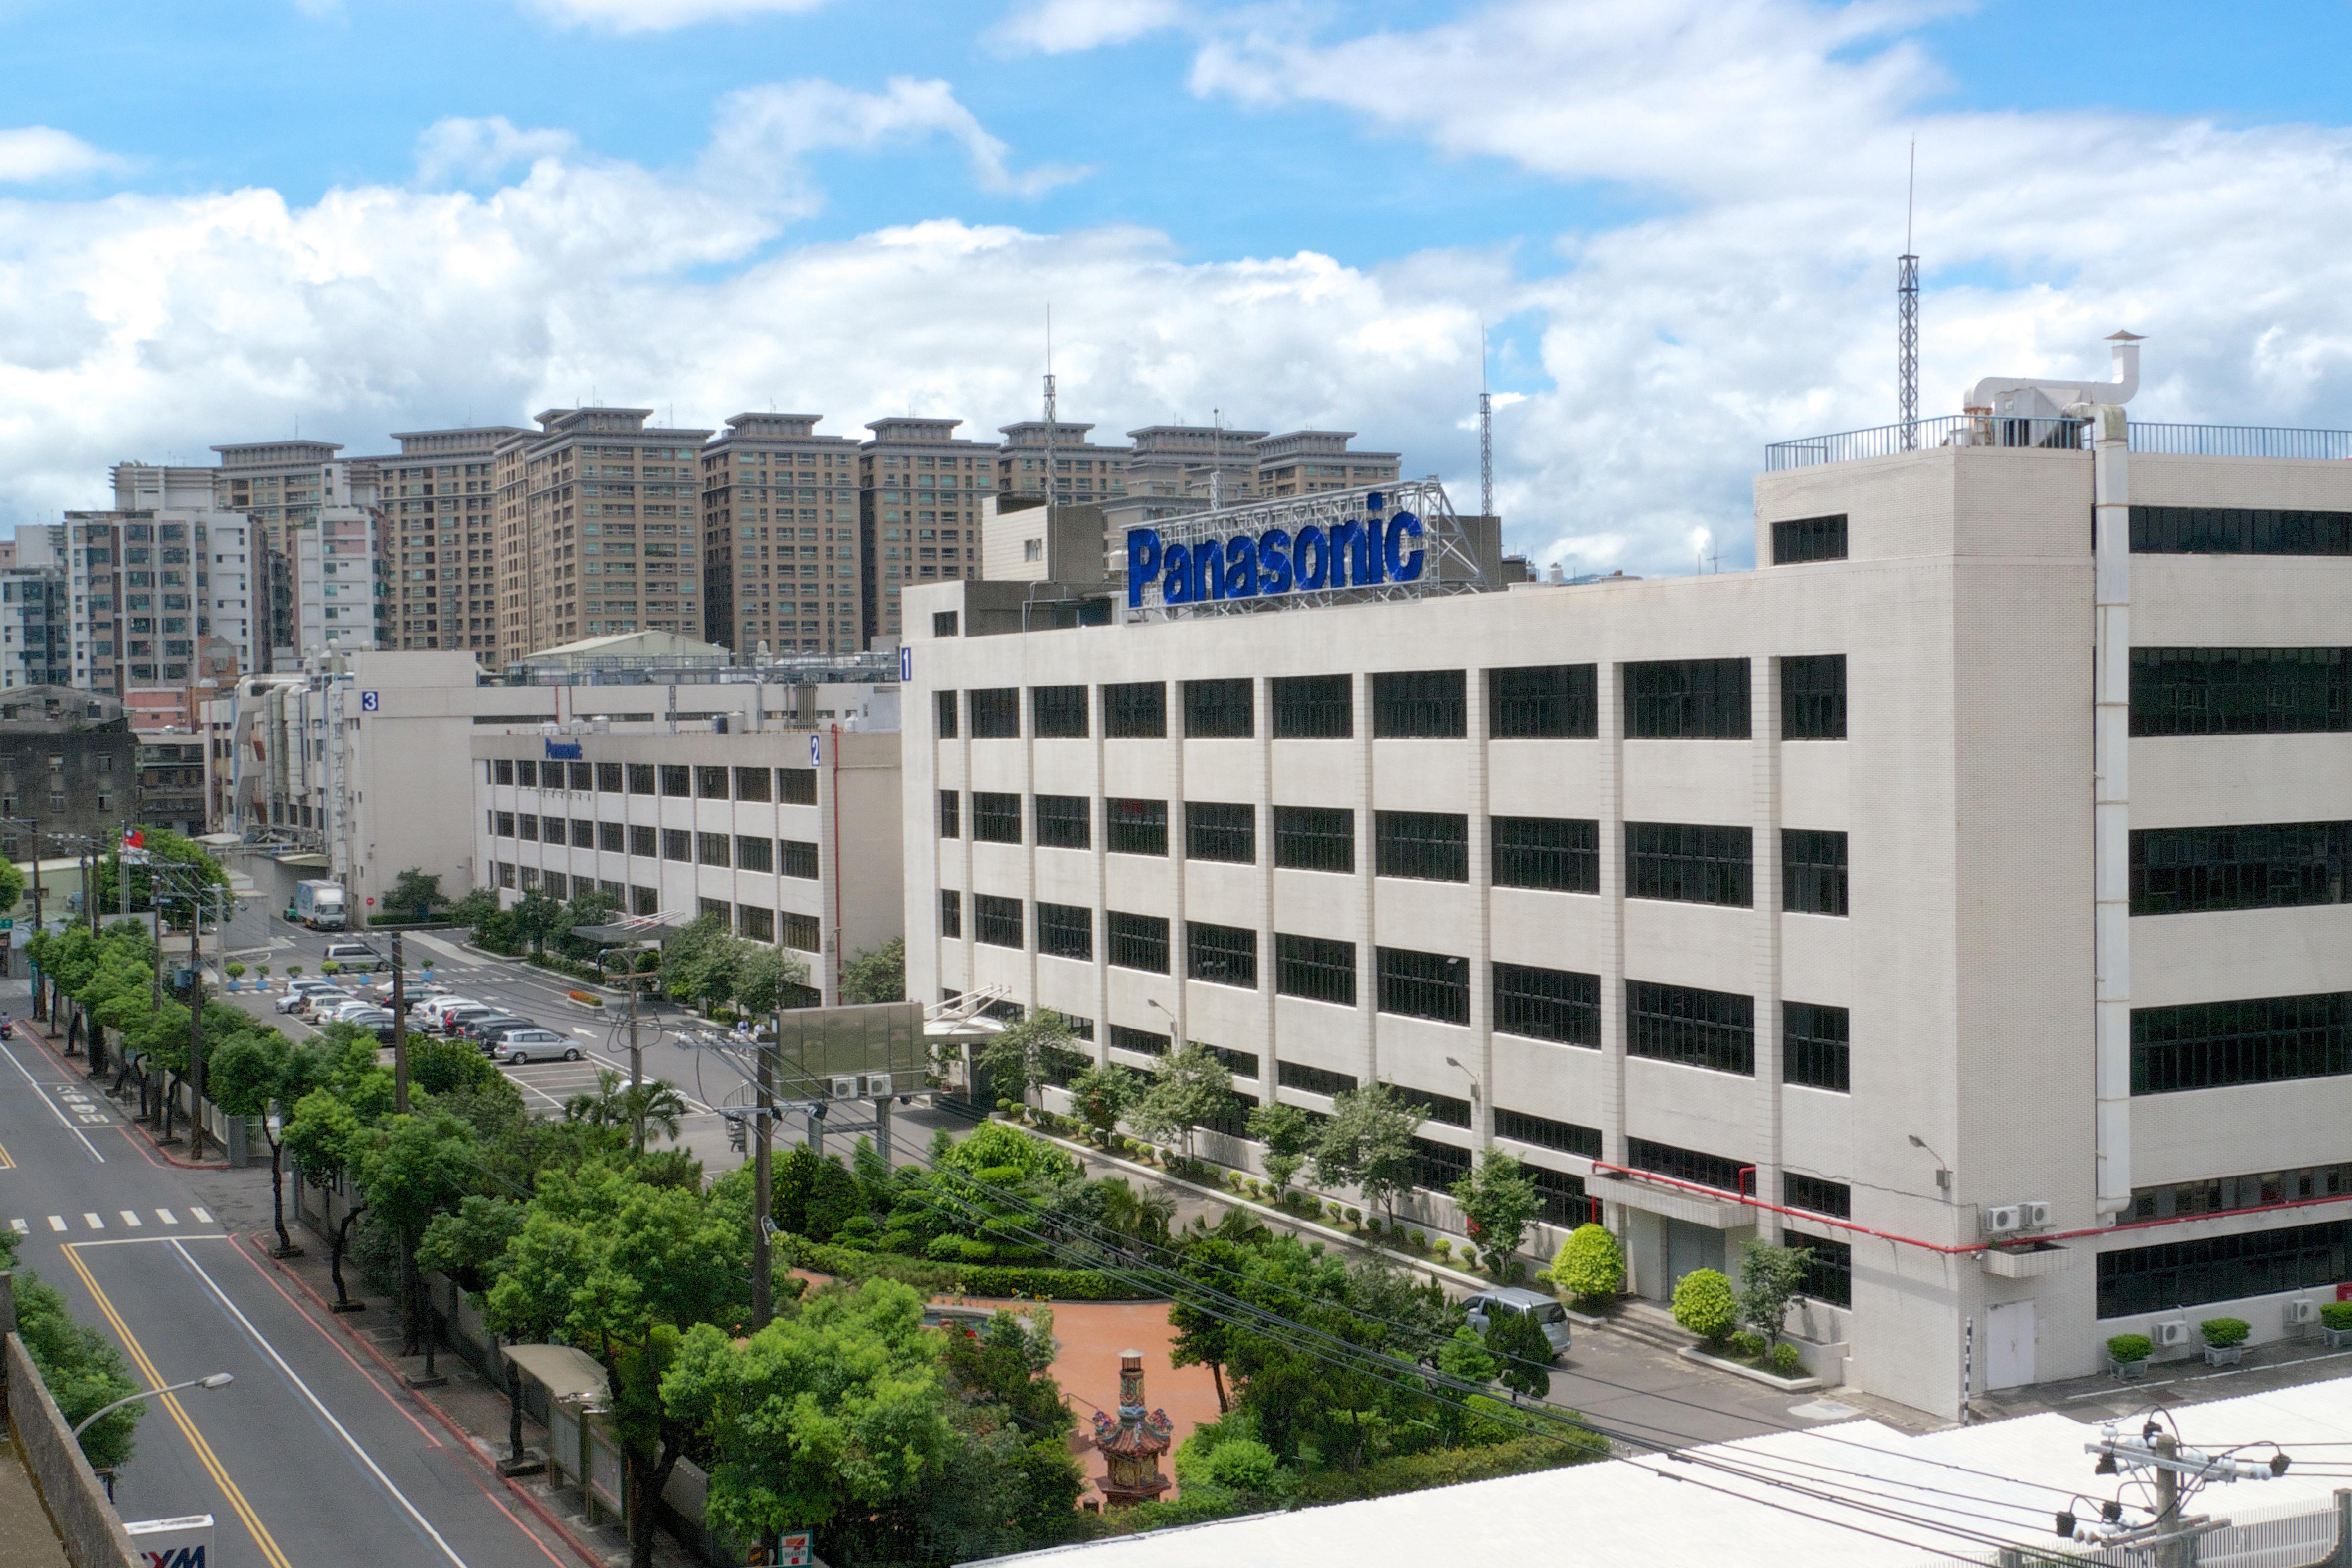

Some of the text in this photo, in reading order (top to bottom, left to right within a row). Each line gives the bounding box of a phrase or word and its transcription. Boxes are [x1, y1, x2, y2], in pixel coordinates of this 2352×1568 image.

[1128, 492, 1425, 608] Panasonic
[903, 649, 909, 680] 1
[364, 692, 377, 710] 3
[812, 737, 819, 765] 2
